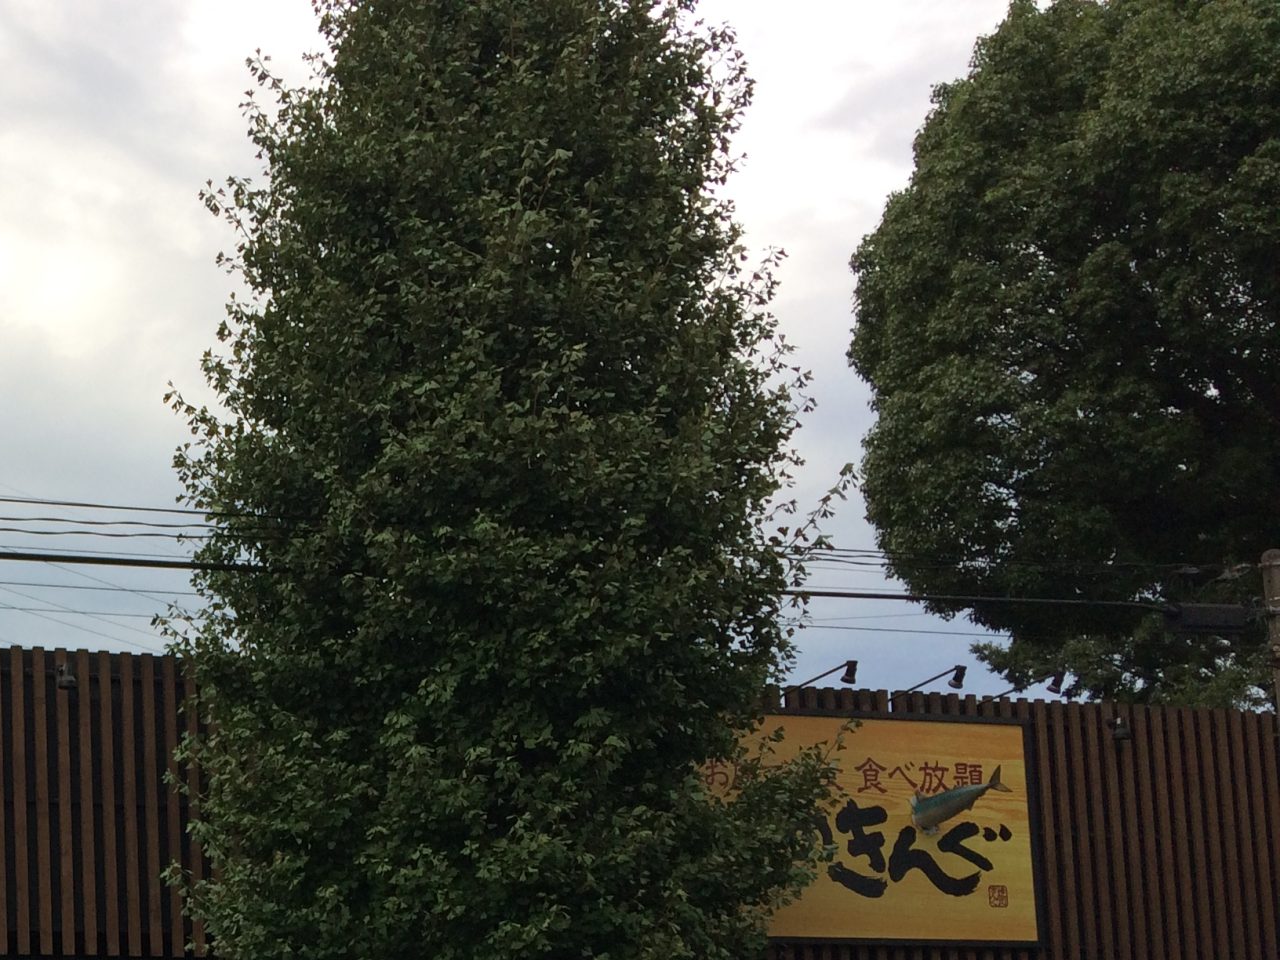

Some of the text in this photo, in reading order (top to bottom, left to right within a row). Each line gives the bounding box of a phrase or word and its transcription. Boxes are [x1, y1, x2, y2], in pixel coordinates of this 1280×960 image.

[854, 757, 984, 795] 食べ放題
[812, 799, 1013, 898] きんぐ
